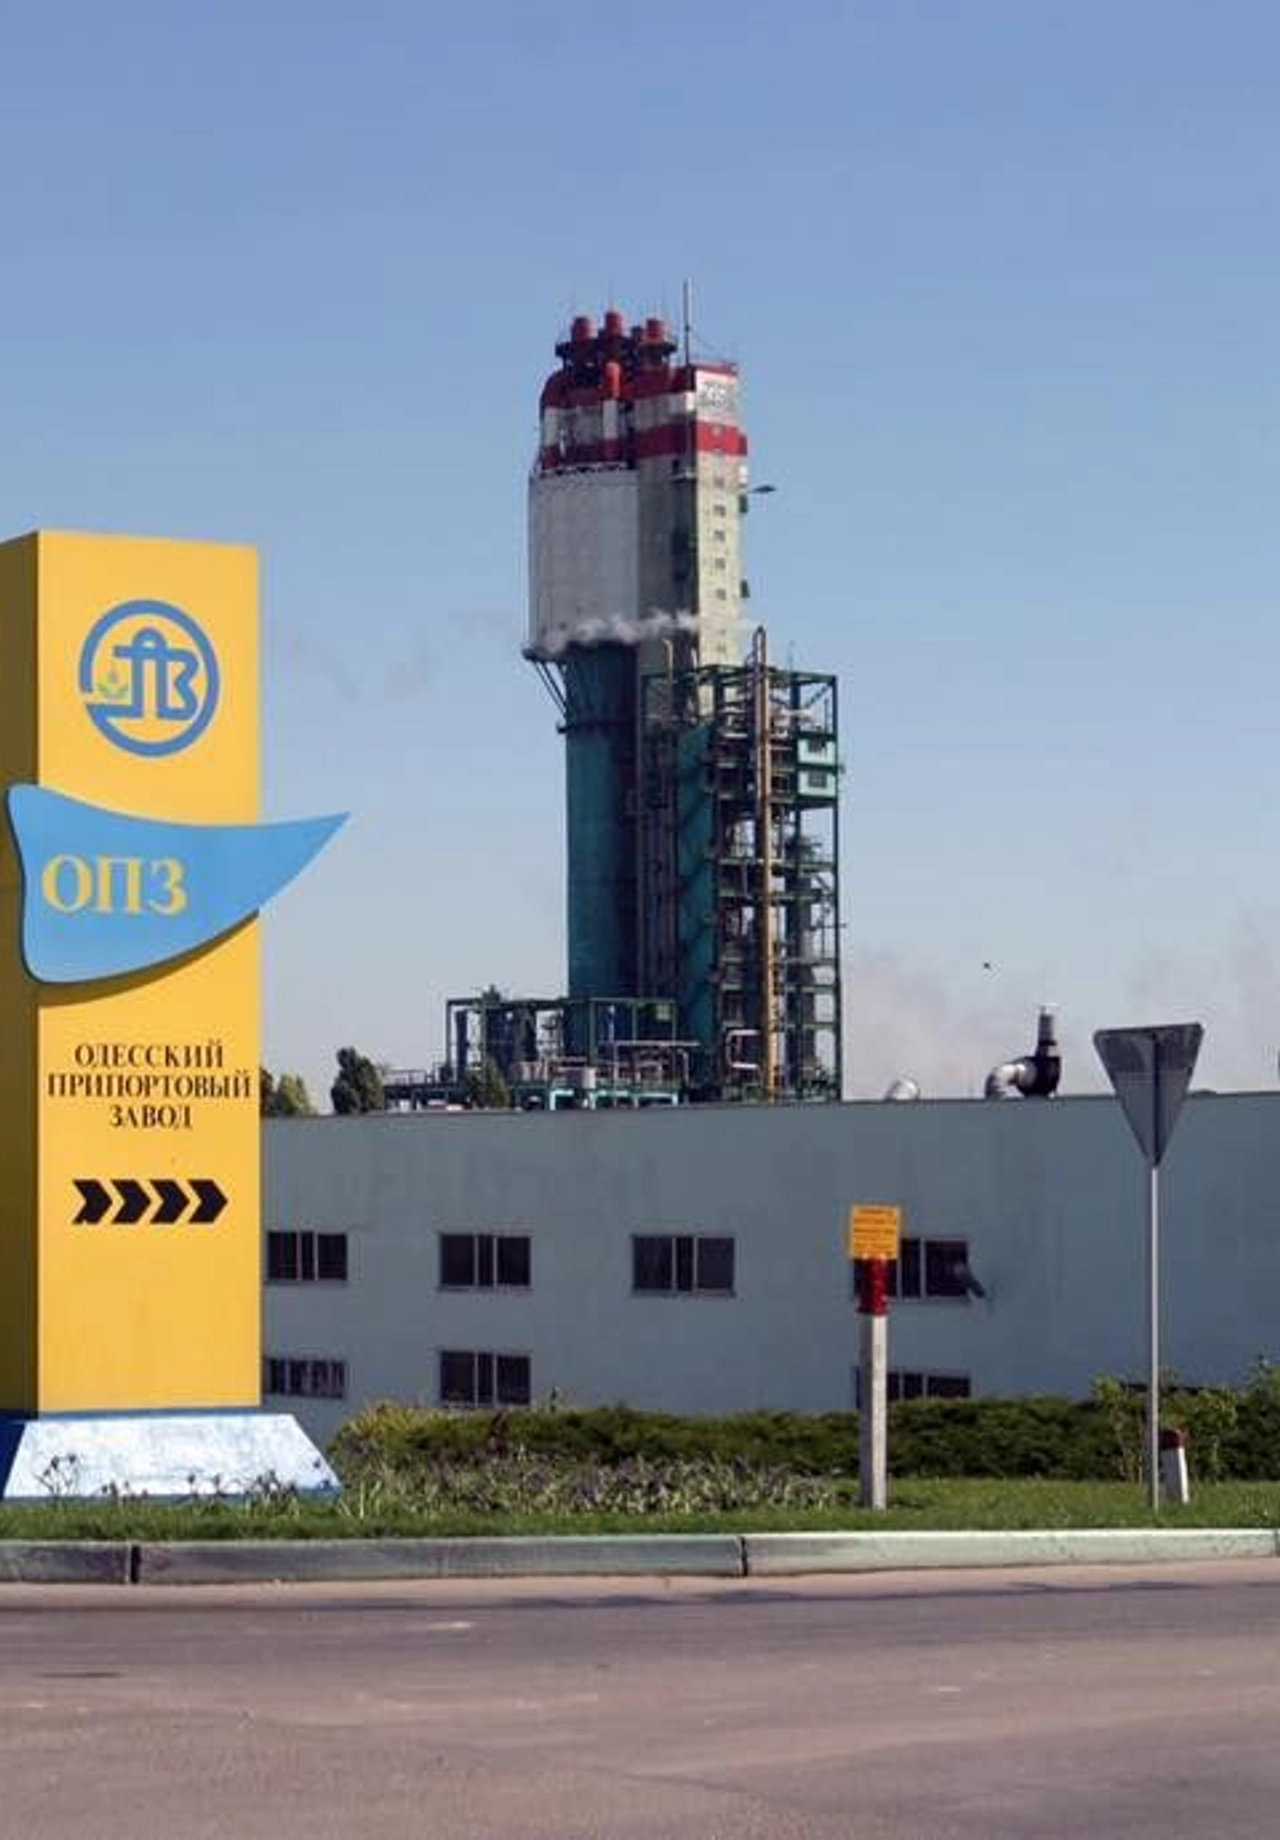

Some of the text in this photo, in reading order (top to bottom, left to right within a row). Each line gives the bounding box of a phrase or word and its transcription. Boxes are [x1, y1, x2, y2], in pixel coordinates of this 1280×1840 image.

[41, 855, 188, 914] ОПЗ
[73, 1038, 223, 1068] ОДЕССКИЙ
[47, 1069, 251, 1098] ПРИПОРТОВЫЙ
[109, 1104, 193, 1130] ЗАВОД
